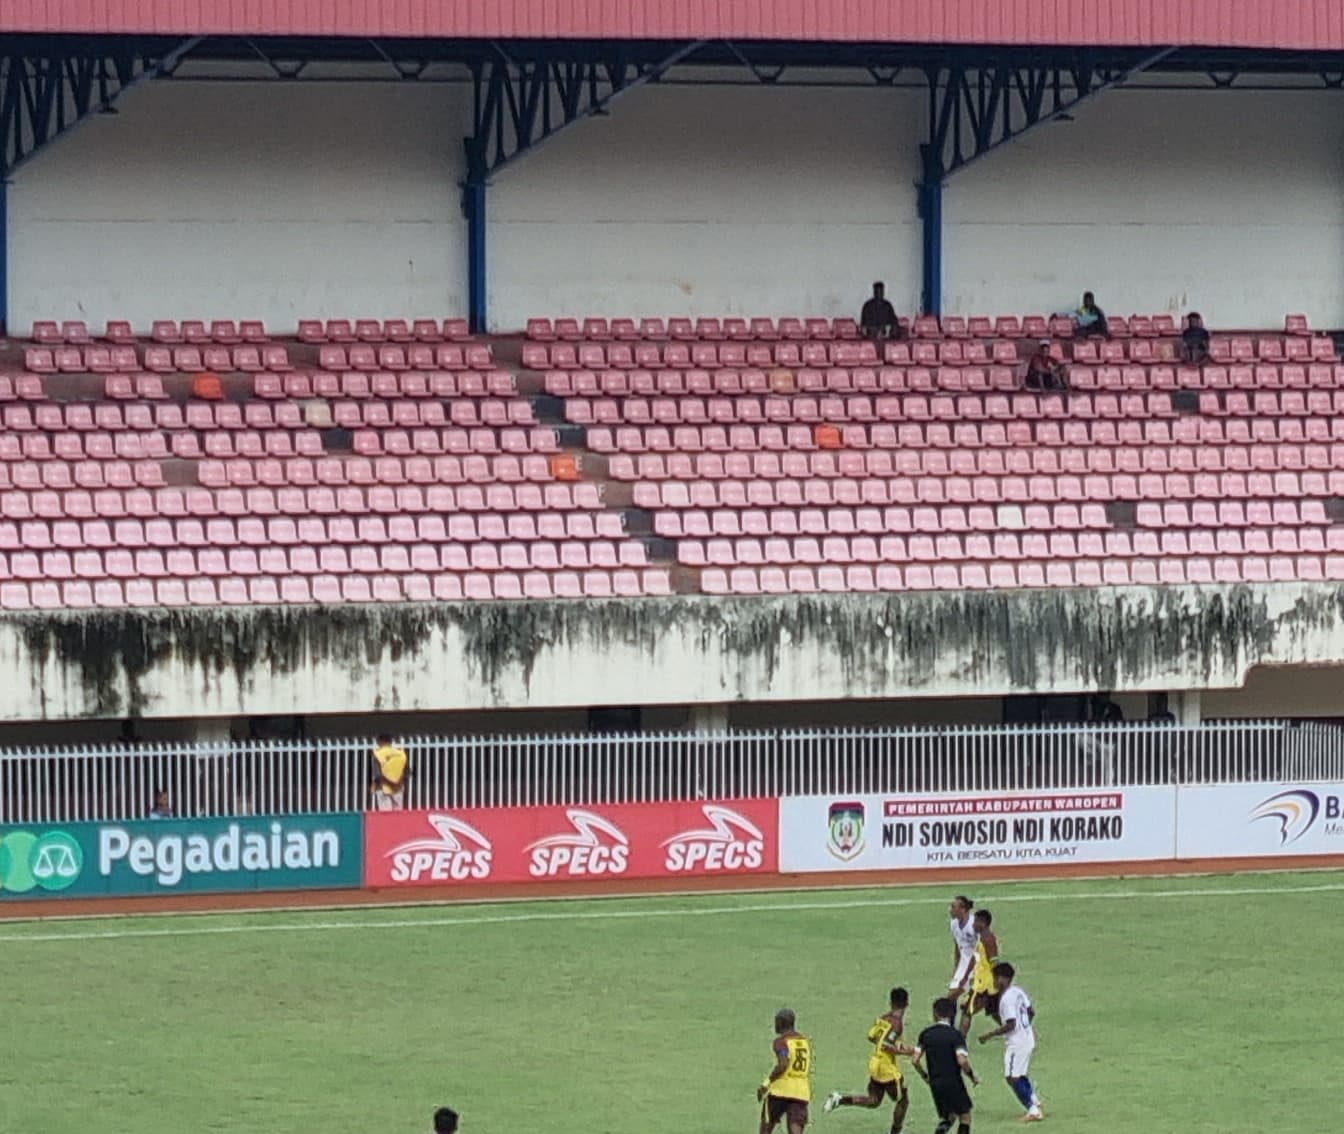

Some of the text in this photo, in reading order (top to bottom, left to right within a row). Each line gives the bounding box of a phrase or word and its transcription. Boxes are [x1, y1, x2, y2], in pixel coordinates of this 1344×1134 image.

[889, 797, 1117, 815] PEMERINTAH KABUPATEN WAROPEN
[883, 815, 1122, 848] NDI SOWOSIO NDI KORAKO
[99, 823, 340, 885] Pegadaian
[390, 849, 491, 882] SPECS
[530, 845, 628, 876] SPECS
[665, 841, 763, 872] SPECS
[927, 851, 954, 862] KITA
[958, 849, 1012, 860] BERSATU
[1016, 848, 1042, 859] KITA
